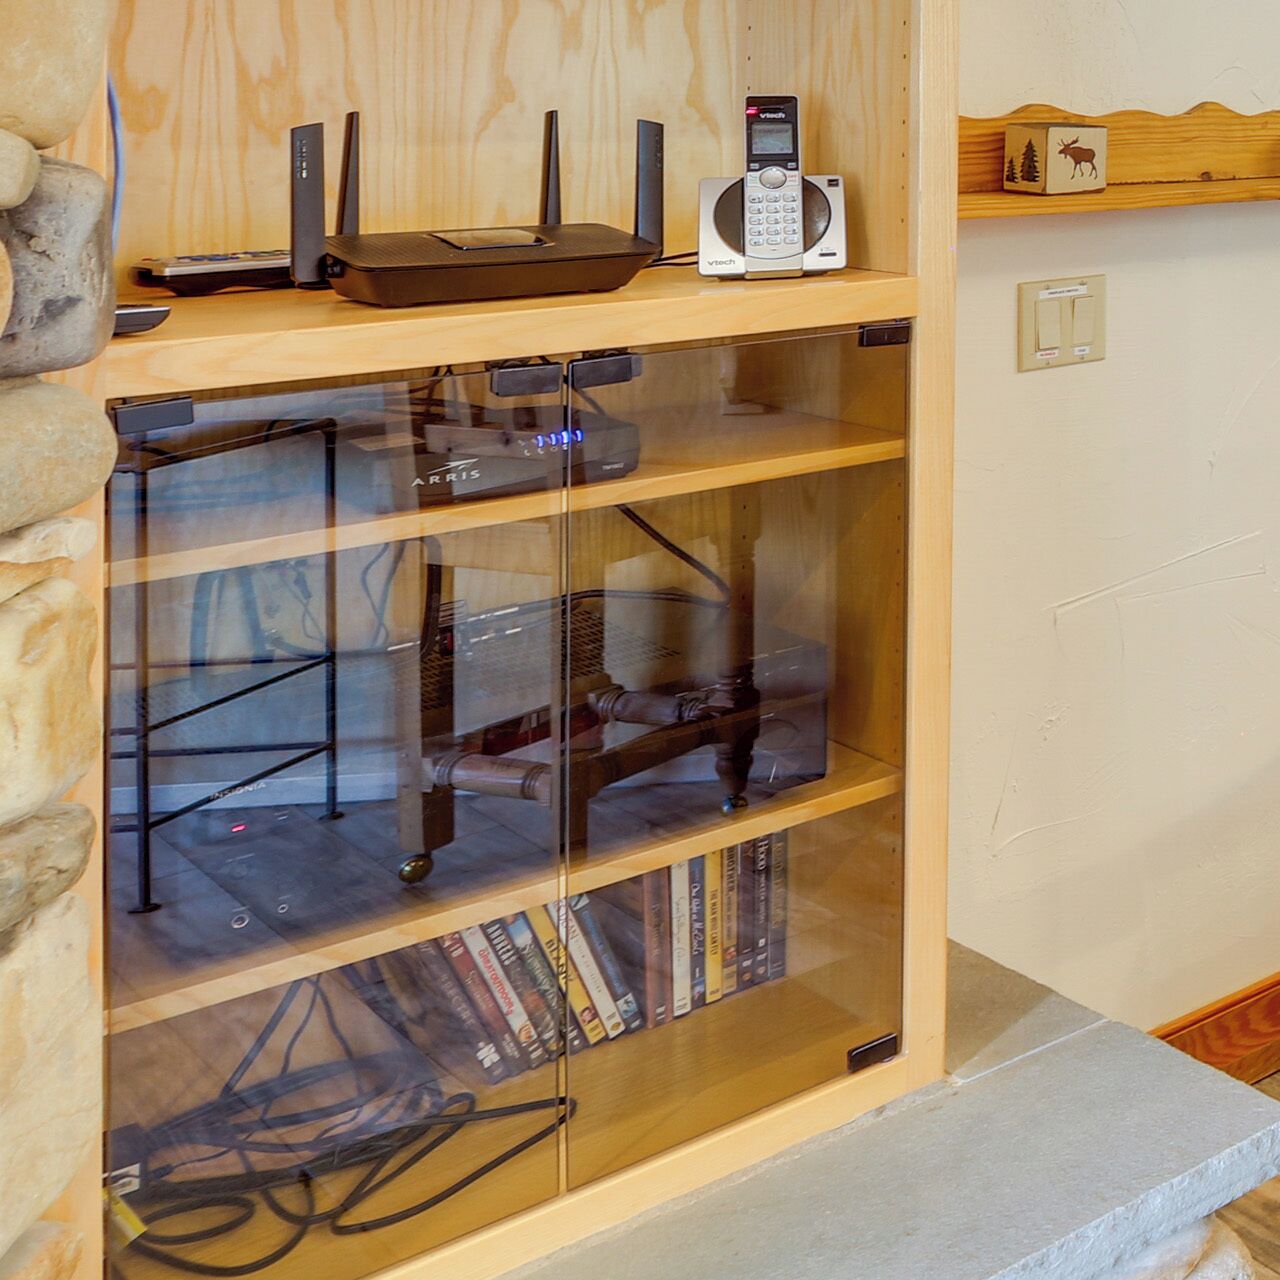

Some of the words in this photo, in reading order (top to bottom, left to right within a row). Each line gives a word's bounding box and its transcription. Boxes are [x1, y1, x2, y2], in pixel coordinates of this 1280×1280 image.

[707, 258, 736, 267] vtech
[411, 469, 481, 487] ARRIS
[486, 923, 518, 966] ANDREAS
